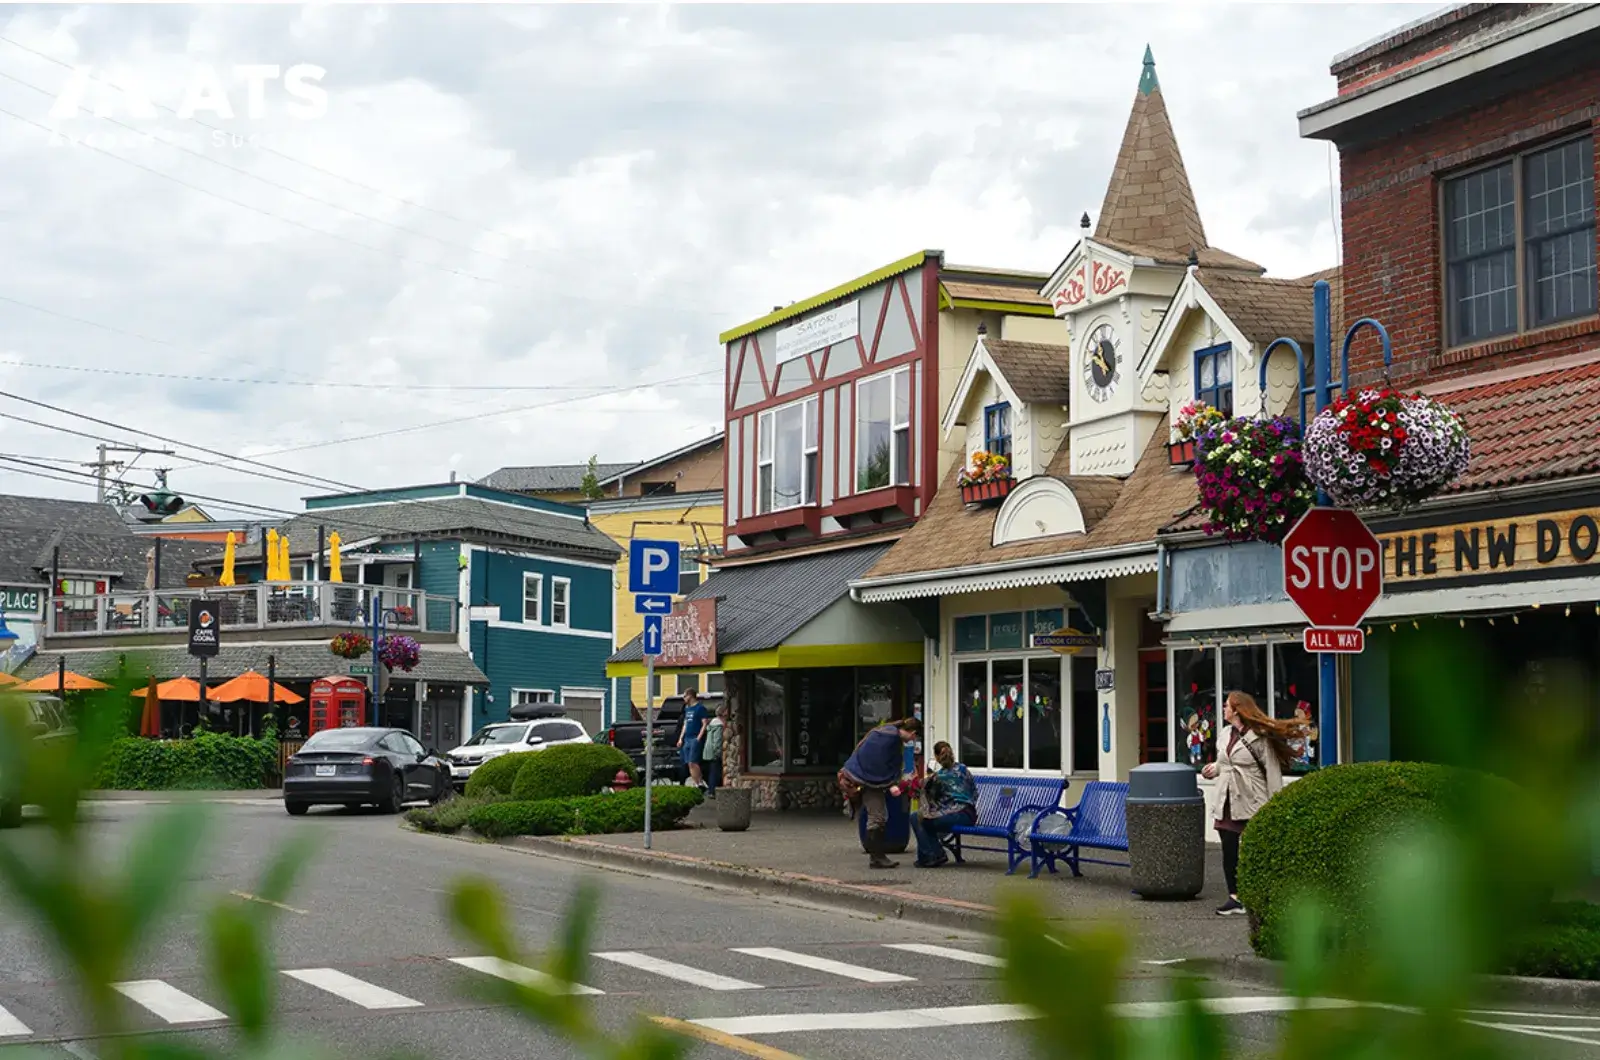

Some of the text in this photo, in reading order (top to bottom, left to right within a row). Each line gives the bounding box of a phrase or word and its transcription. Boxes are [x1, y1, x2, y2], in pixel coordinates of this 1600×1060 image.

[1454, 523, 1517, 571] NW
[1536, 514, 1599, 563] DO
[642, 547, 670, 586] P
[1290, 545, 1375, 590] STOP
[0, 591, 37, 609] PLACE
[1310, 633, 1358, 647] ALL WAY
